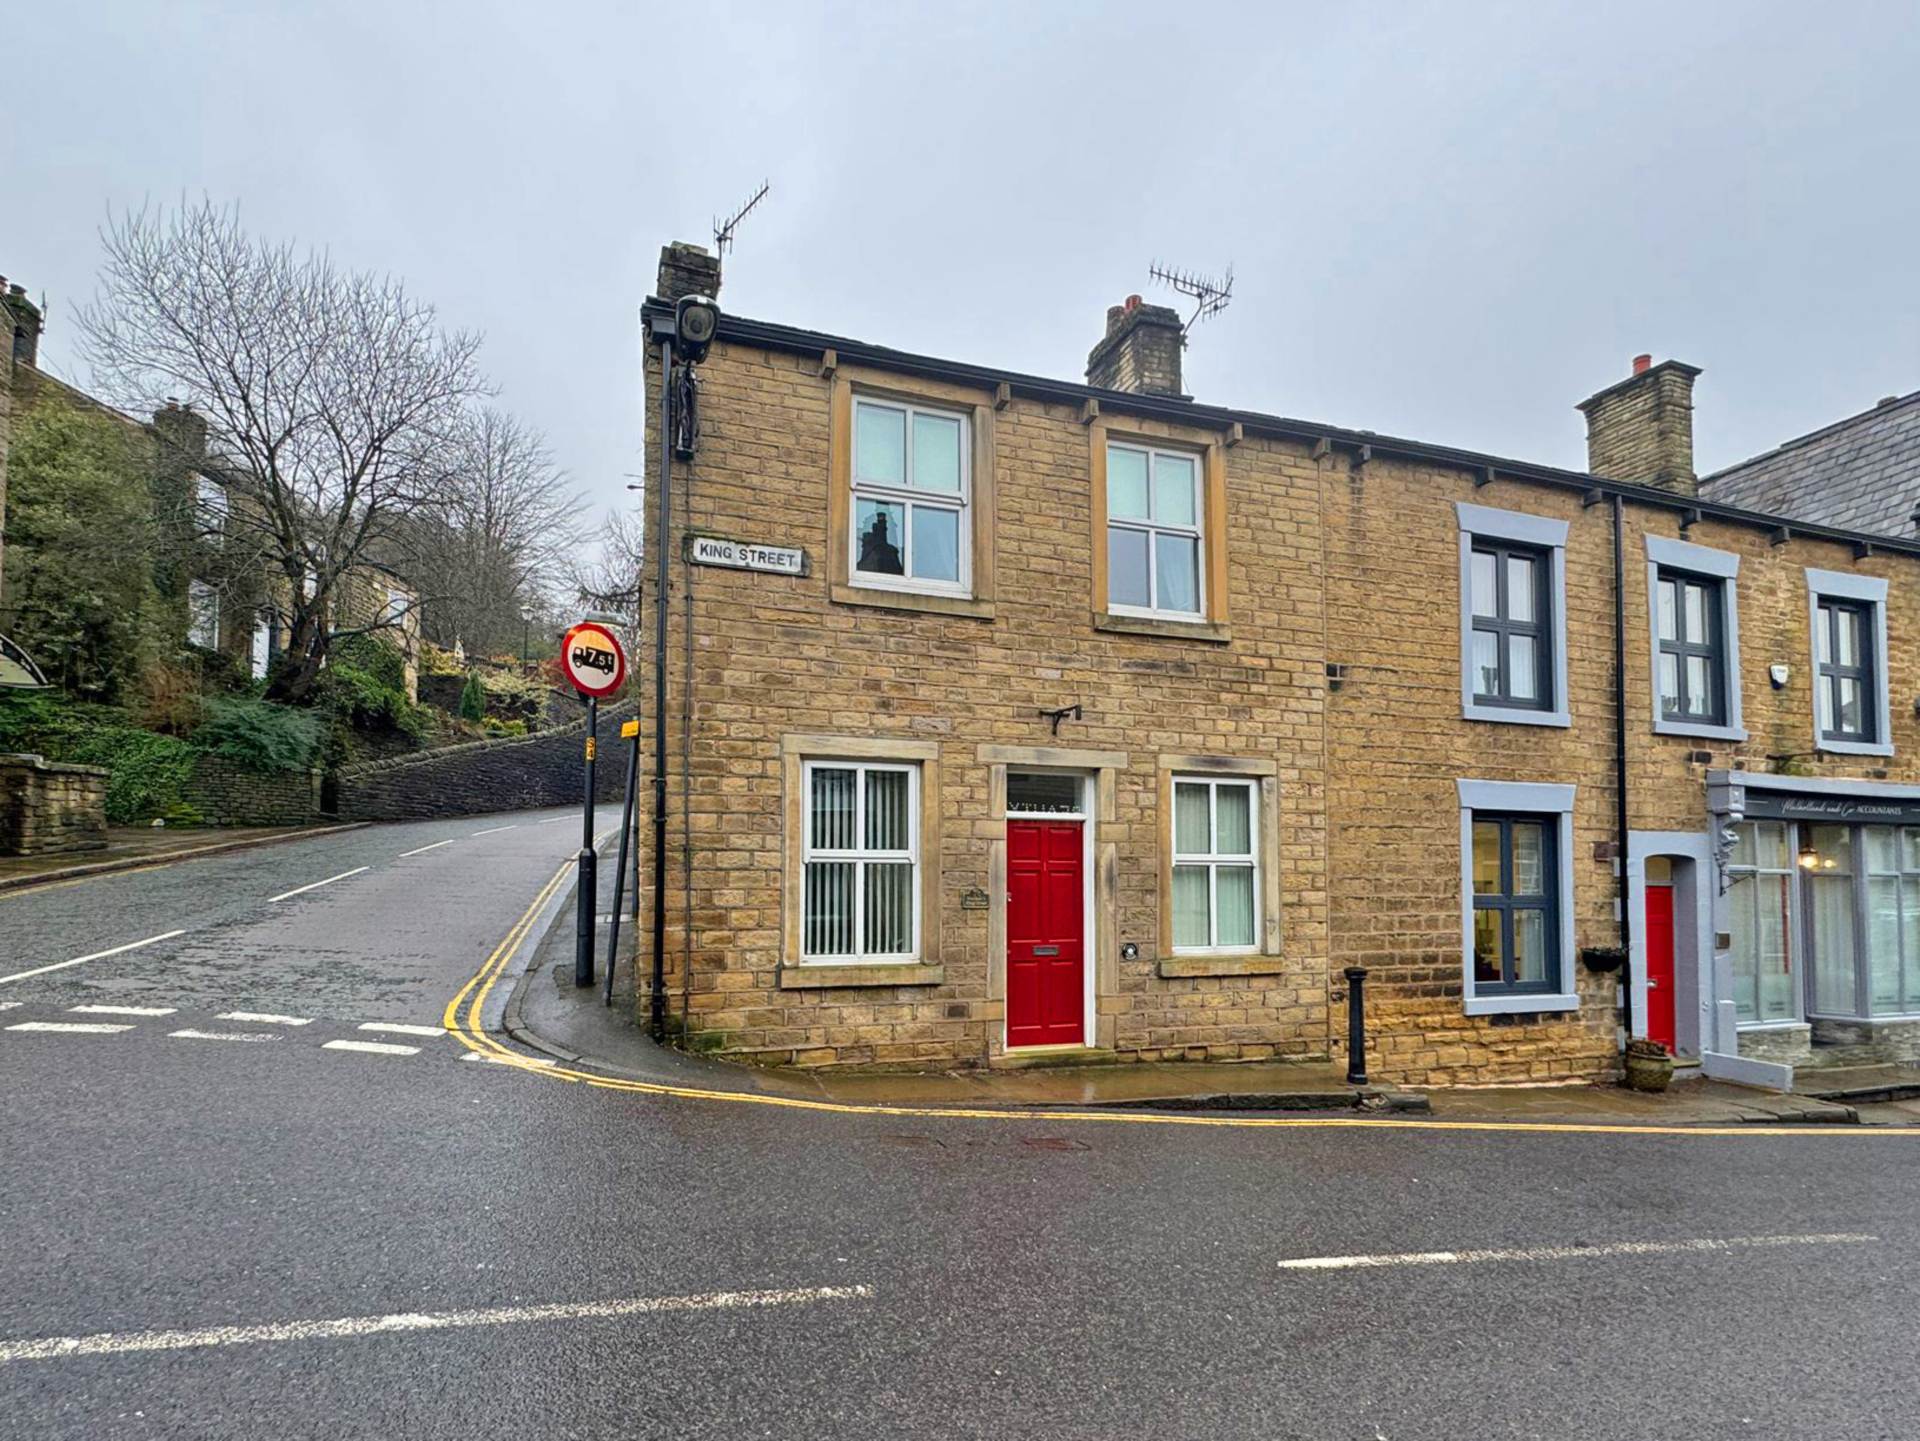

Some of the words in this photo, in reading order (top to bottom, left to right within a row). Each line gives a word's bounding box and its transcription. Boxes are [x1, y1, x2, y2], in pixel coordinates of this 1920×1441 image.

[699, 543, 732, 559] KING
[739, 548, 795, 567] STREET
[1856, 805, 1903, 816] ACCOUNTANTS
